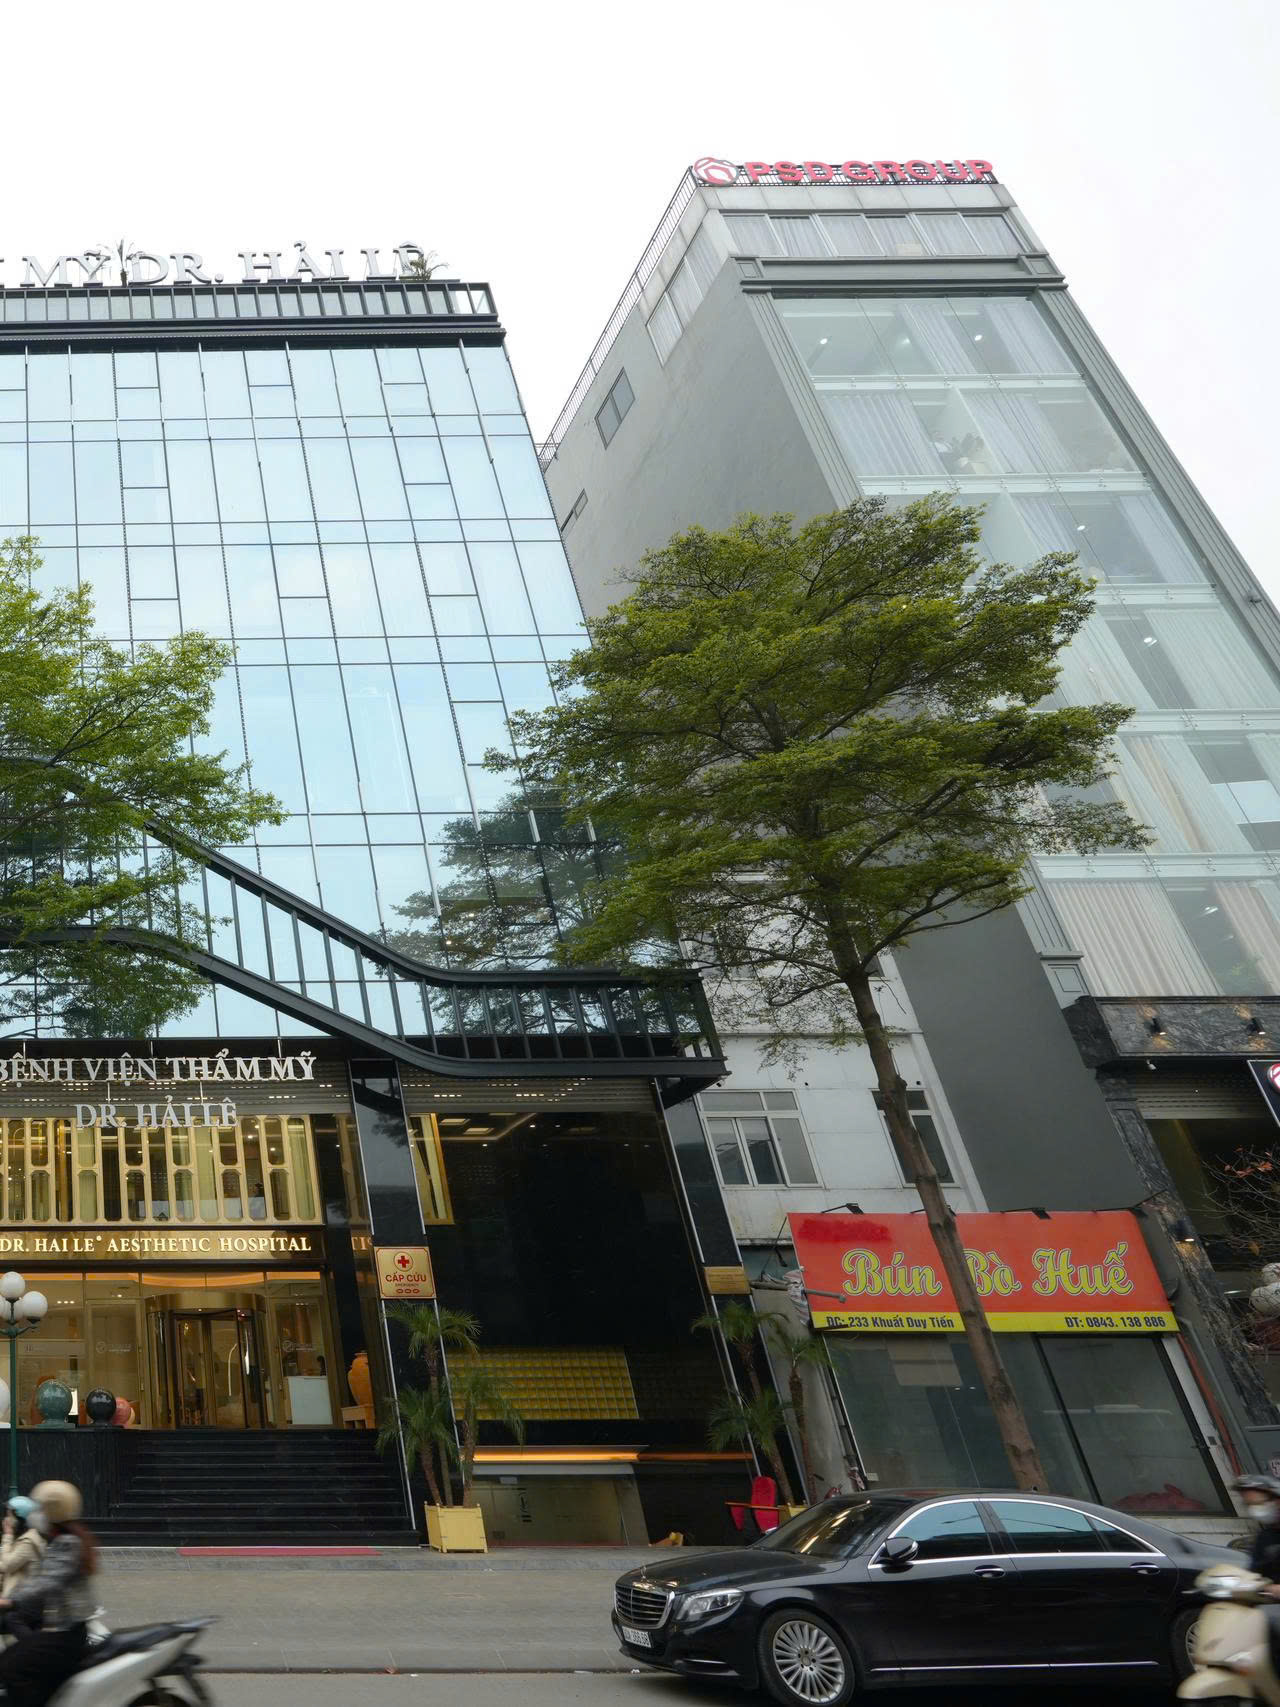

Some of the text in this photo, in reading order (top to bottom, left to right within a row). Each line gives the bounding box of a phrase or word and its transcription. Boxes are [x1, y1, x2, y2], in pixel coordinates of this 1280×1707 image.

[743, 159, 993, 182] PSD GROUP
[127, 250, 224, 285] DR.
[238, 240, 349, 284] HẢI
[82, 1052, 158, 1086] VIỆN
[166, 1048, 263, 1081] THẨM
[268, 1051, 317, 1081] MỸ
[75, 1094, 238, 1128] DR. HẢI LÊ
[0, 1238, 29, 1252] DR.
[35, 1238, 68, 1252] HAI
[107, 1237, 211, 1252] AESTHETIC
[219, 1237, 312, 1251] HOSPITAL
[385, 1271, 405, 1282] CẤP
[841, 1248, 942, 1296] Bún
[1032, 1242, 1134, 1296] Huế
[848, 1316, 869, 1328] 233
[872, 1314, 903, 1328] Khuất
[929, 1314, 955, 1328] Tiến
[1065, 1316, 1166, 1328] ĐT: 0843. 138 886
